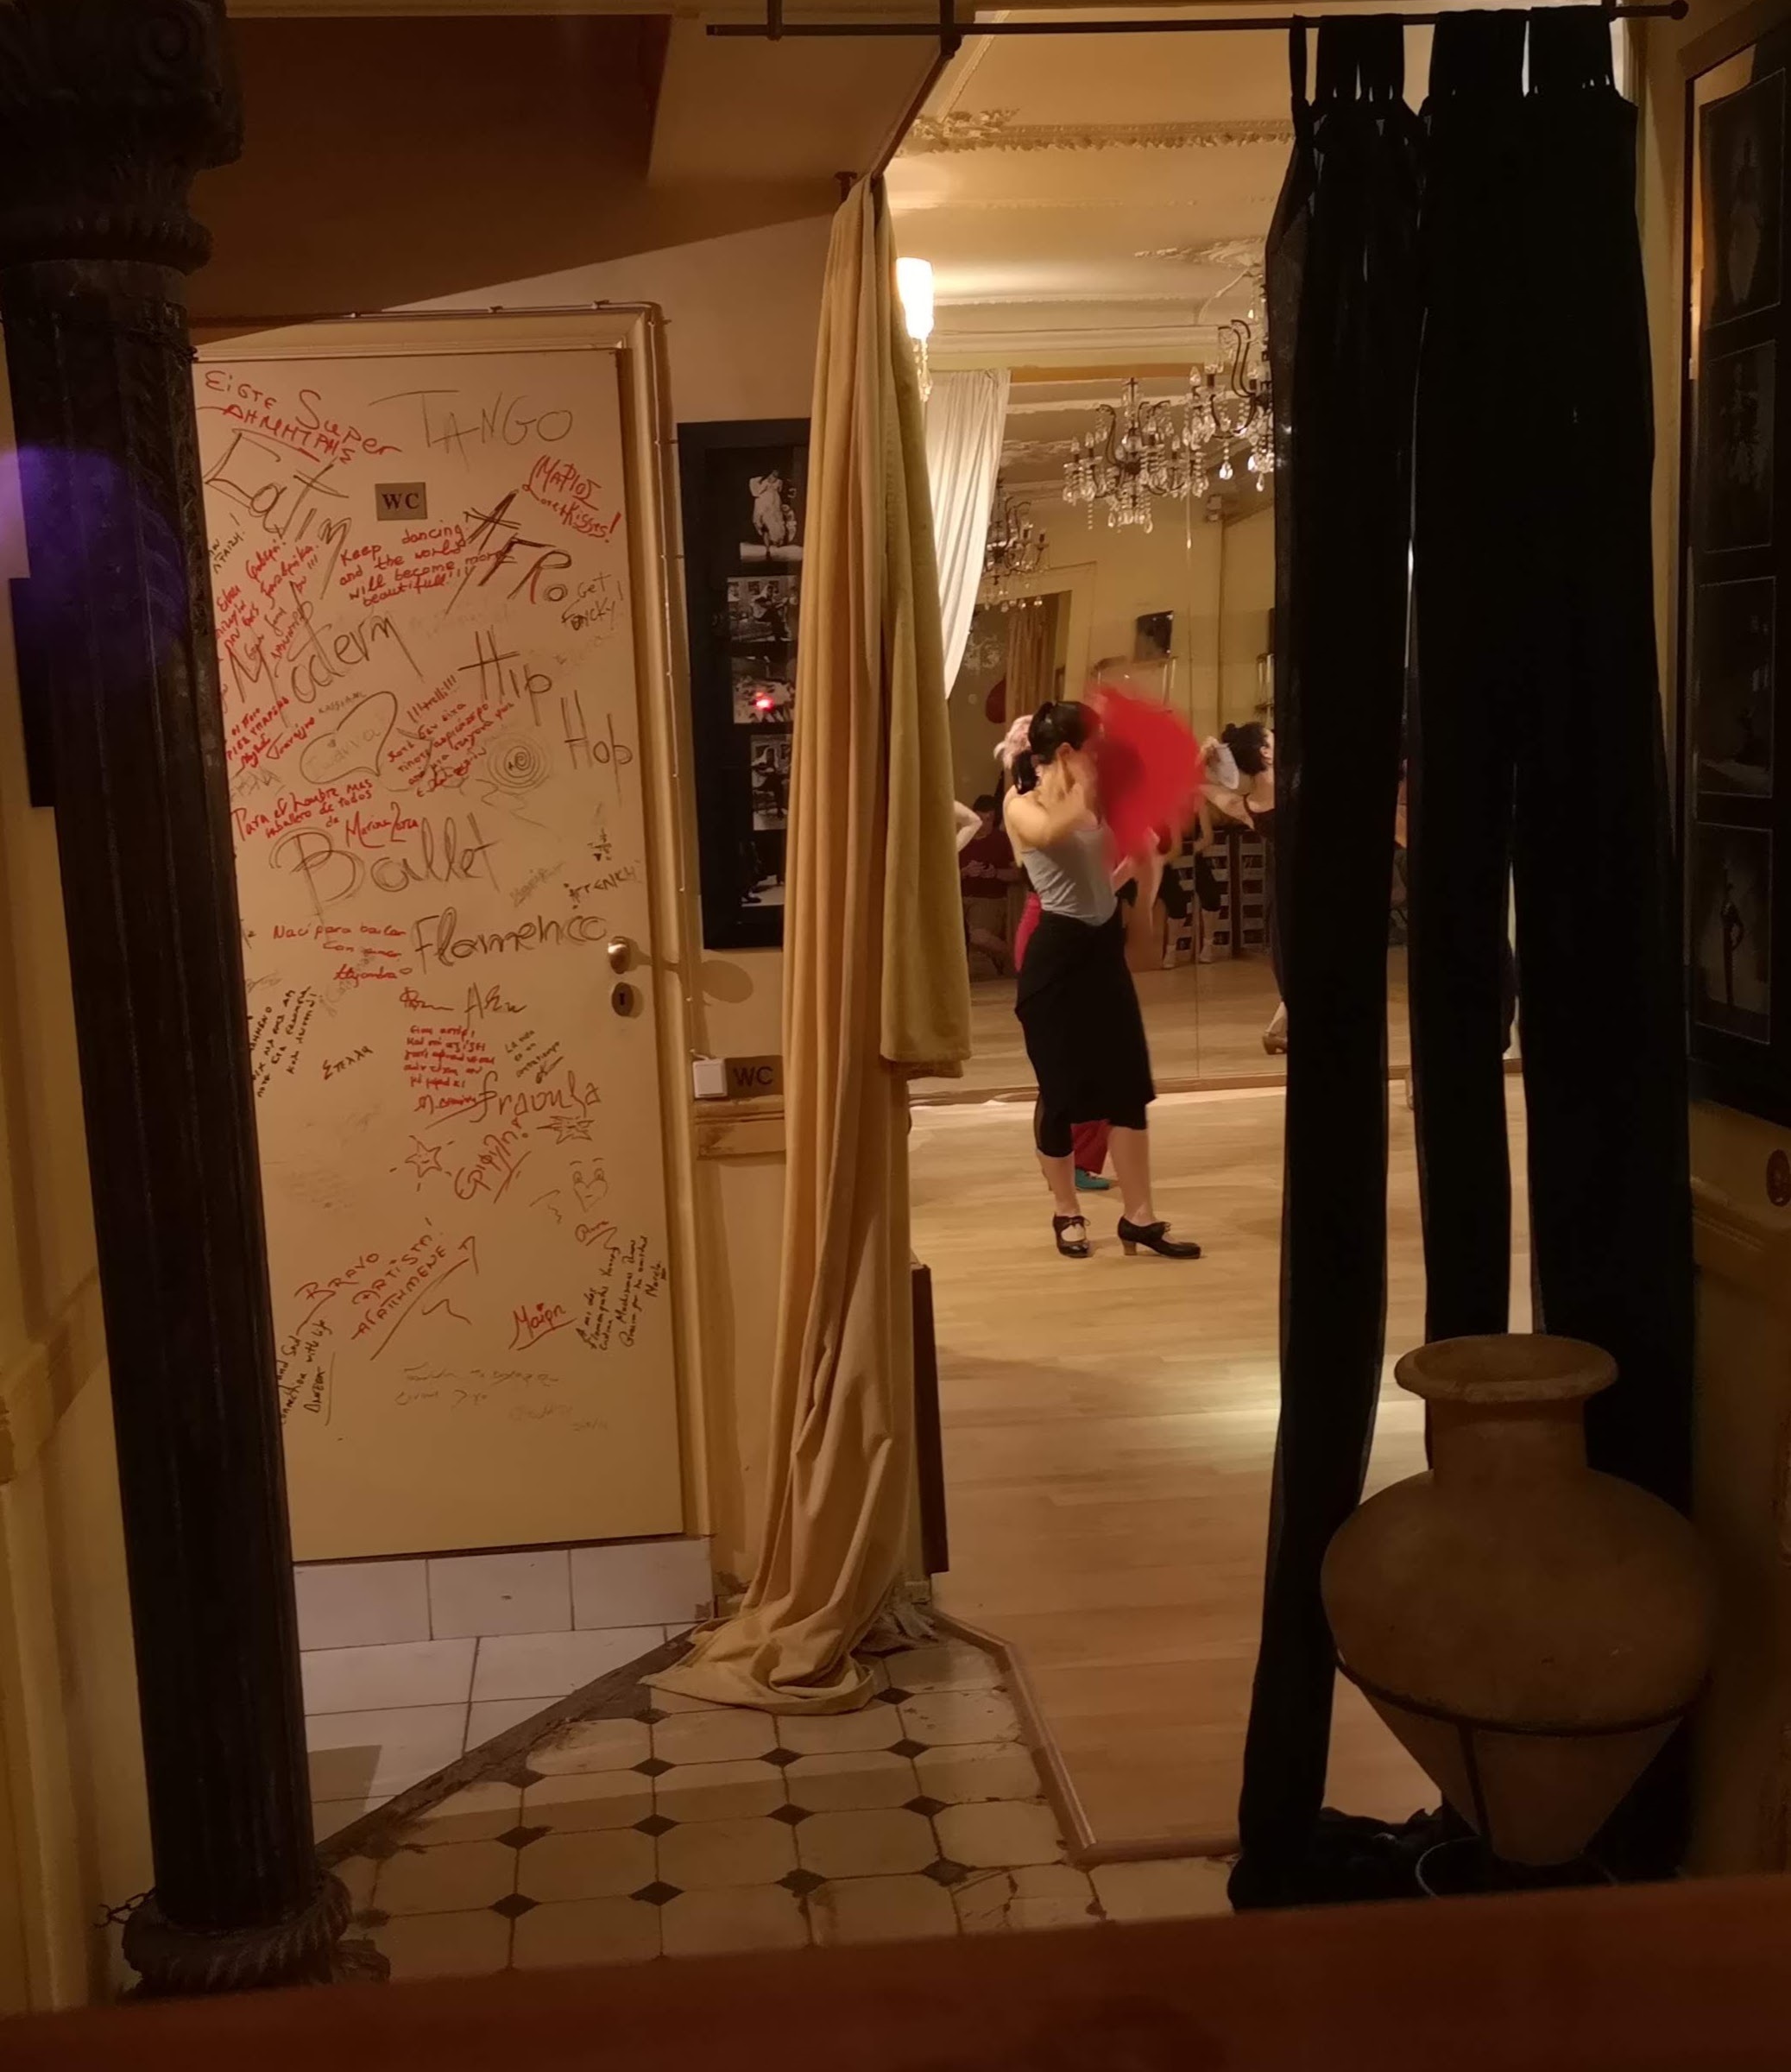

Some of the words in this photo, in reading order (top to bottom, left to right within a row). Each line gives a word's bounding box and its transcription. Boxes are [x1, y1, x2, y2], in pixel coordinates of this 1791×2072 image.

[295, 388, 403, 457] Super
[368, 389, 573, 471] TANGO
[382, 492, 420, 510] WC
[339, 564, 363, 586] and
[374, 553, 404, 571] the
[414, 539, 467, 559] world
[340, 544, 382, 567] Keep
[401, 521, 465, 546] dancing
[349, 573, 386, 601] will
[394, 561, 455, 582] become
[577, 571, 612, 598] Get
[224, 581, 426, 728] Modern
[457, 623, 552, 727] Hip
[560, 689, 634, 810] Hop
[229, 807, 270, 842] Para
[268, 812, 501, 931] Ballet
[313, 925, 352, 940] para
[411, 906, 608, 975] Flamenco
[732, 1065, 774, 1087] WC
